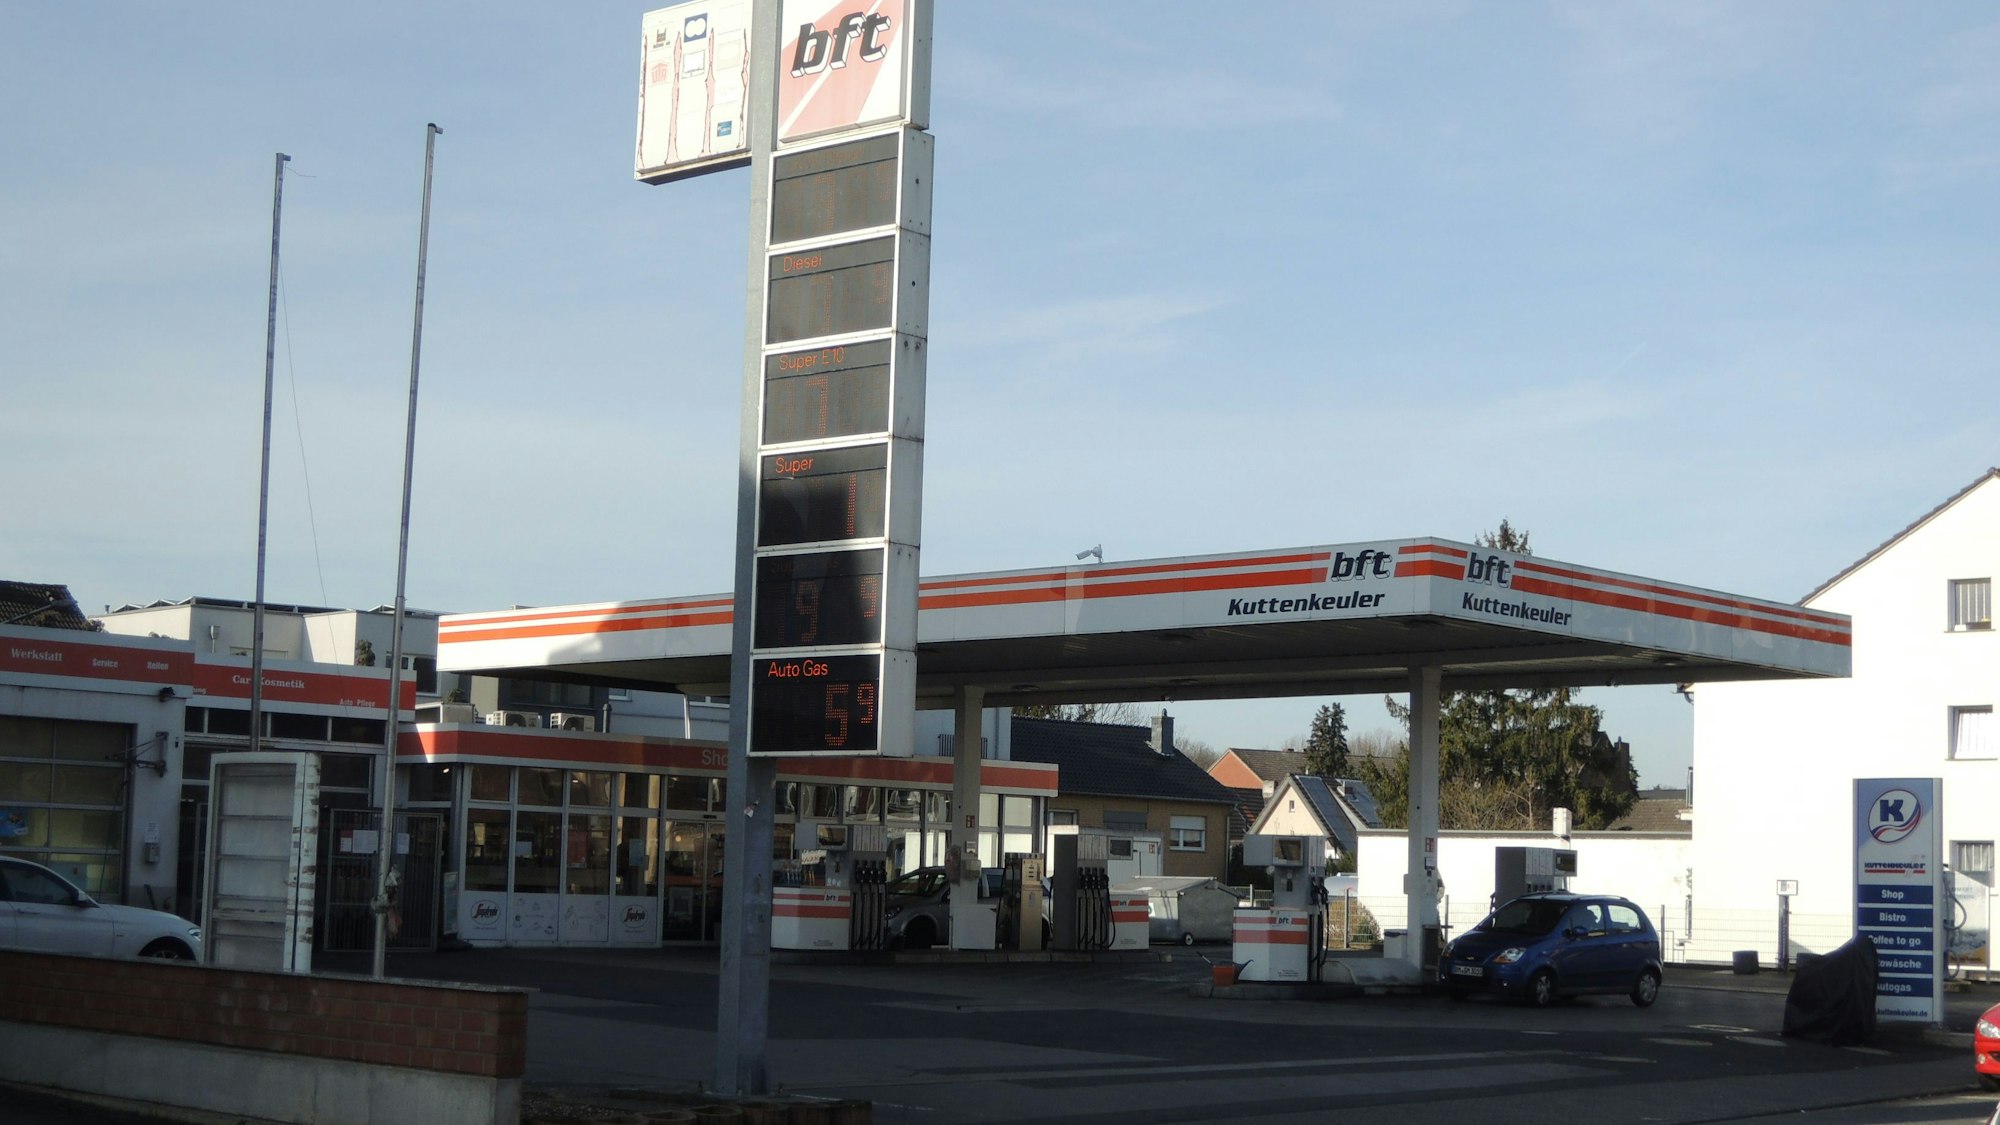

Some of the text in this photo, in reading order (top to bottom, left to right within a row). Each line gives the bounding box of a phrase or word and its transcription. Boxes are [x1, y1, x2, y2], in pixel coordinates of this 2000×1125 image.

[790, 11, 891, 78] bft
[783, 253, 822, 272] Diesel
[779, 346, 846, 372] Super E10
[775, 456, 814, 476] Super
[1330, 549, 1393, 583] bft
[1467, 551, 1512, 588] bft
[1227, 591, 1386, 616] Kuttenkeuler
[1461, 591, 1572, 627] Kuttenkeuler
[10, 647, 64, 662] Werkstatt
[91, 657, 119, 669] Service
[768, 659, 829, 679] Auto Gas
[232, 674, 250, 685] Car
[701, 749, 729, 767] Sho
[1879, 799, 1904, 822] K
[1881, 889, 1905, 900] Shop
[1879, 912, 1907, 922] Bistro
[1896, 935, 1907, 945] to
[1909, 937, 1921, 947] go
